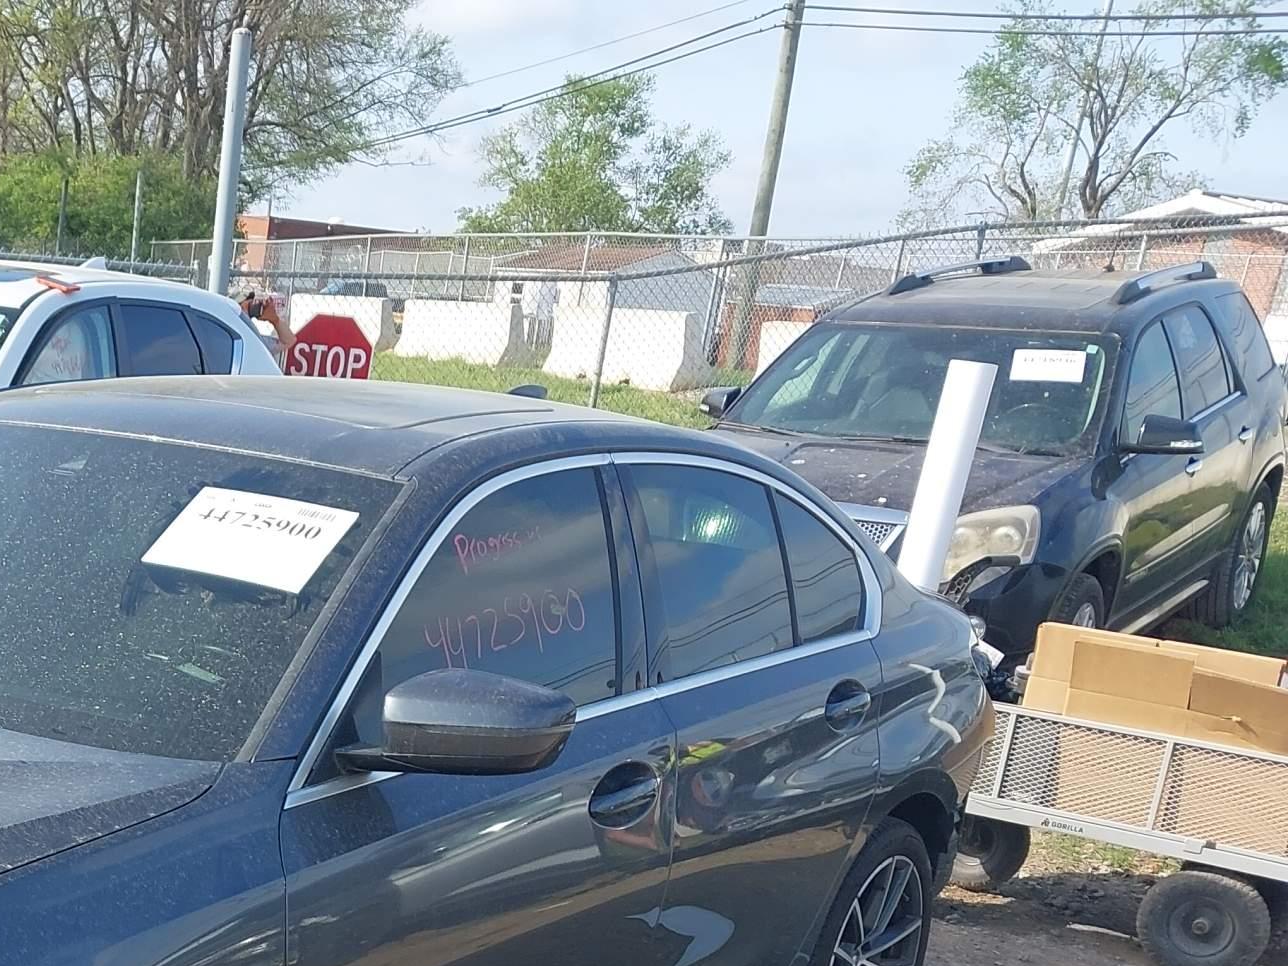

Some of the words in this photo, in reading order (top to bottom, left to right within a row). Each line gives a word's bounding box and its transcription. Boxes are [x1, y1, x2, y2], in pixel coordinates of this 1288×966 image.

[290, 342, 367, 378] STOP
[198, 507, 322, 540] 44725900
[1051, 821, 1084, 833] GORILLA
